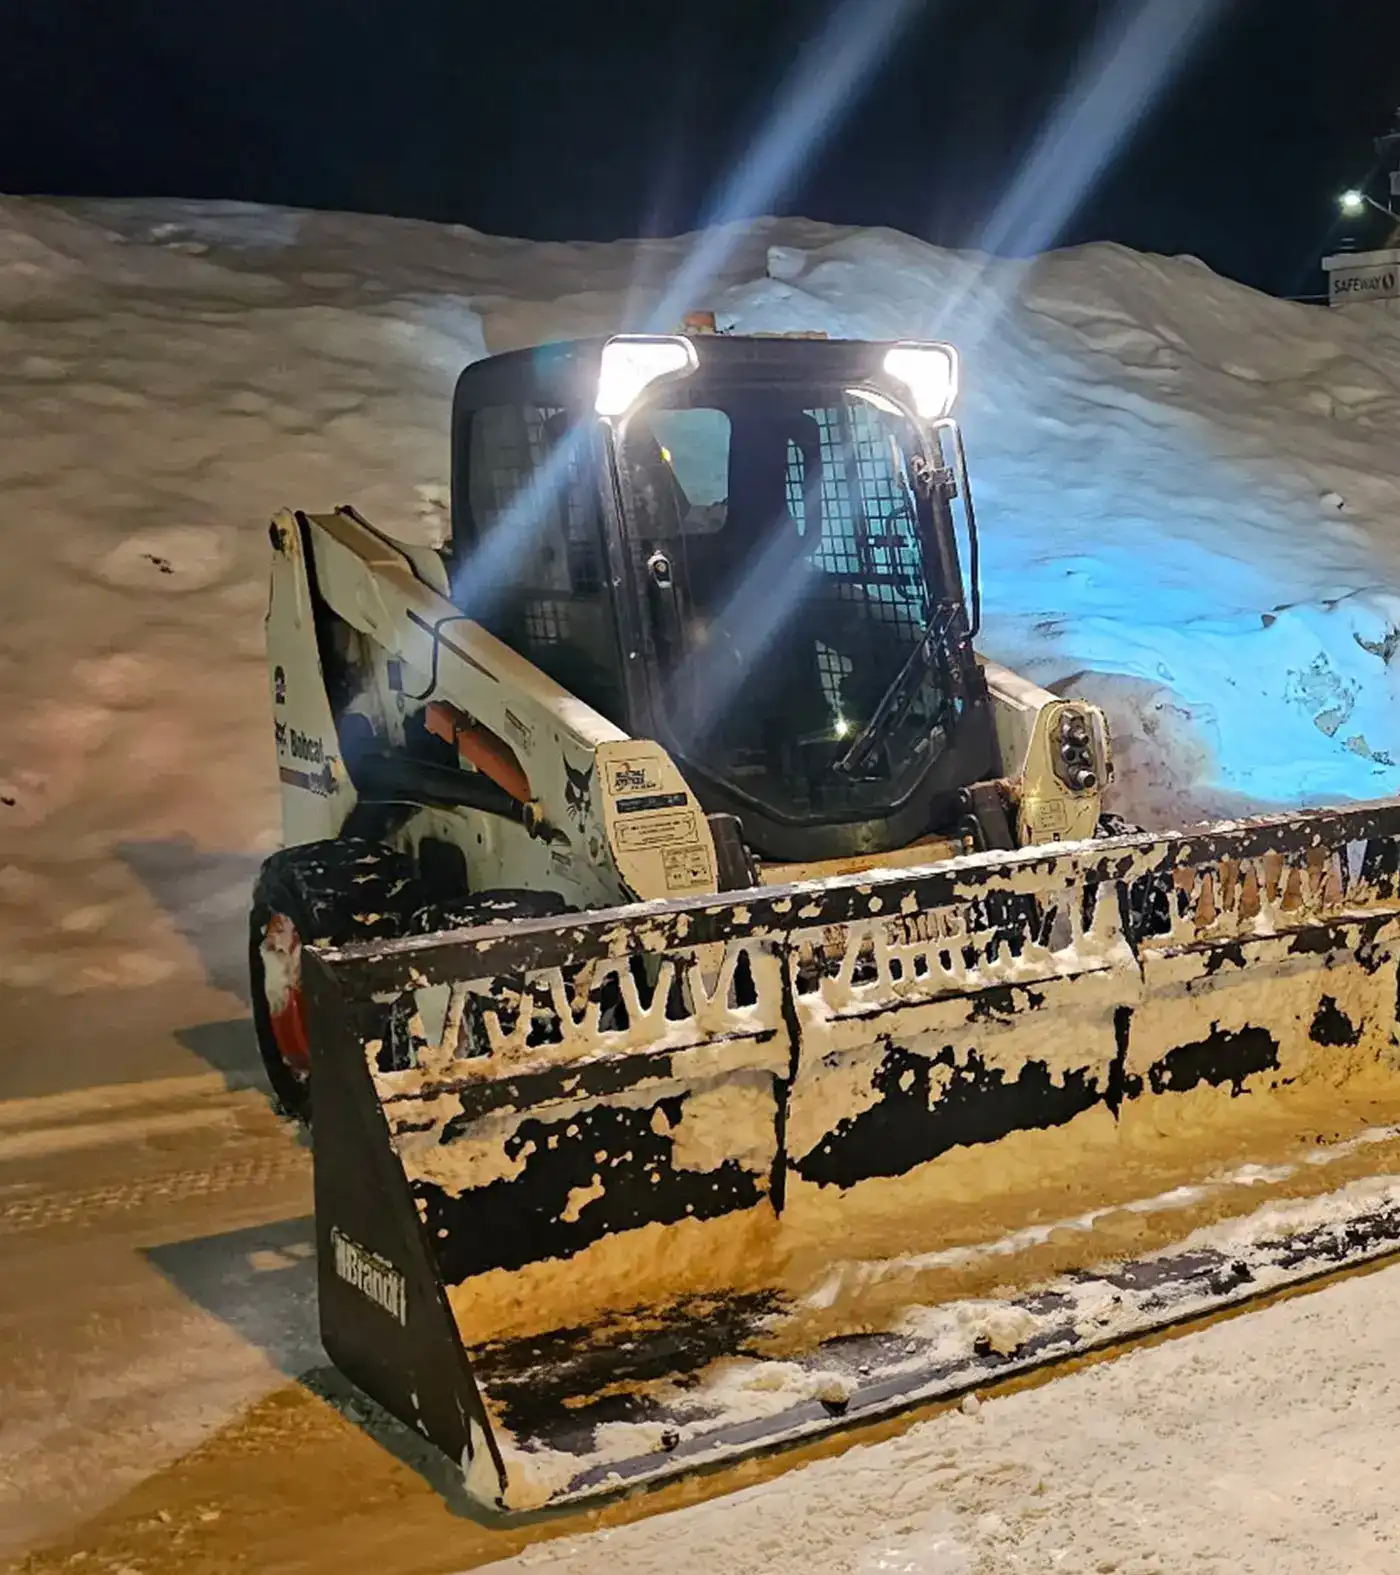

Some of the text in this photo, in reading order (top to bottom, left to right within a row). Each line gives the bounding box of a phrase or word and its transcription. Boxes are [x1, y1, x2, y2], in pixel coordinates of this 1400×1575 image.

[1334, 276, 1381, 294] SAFEWAY
[290, 728, 323, 764] Bobcat
[340, 1236, 403, 1322] Brandt
